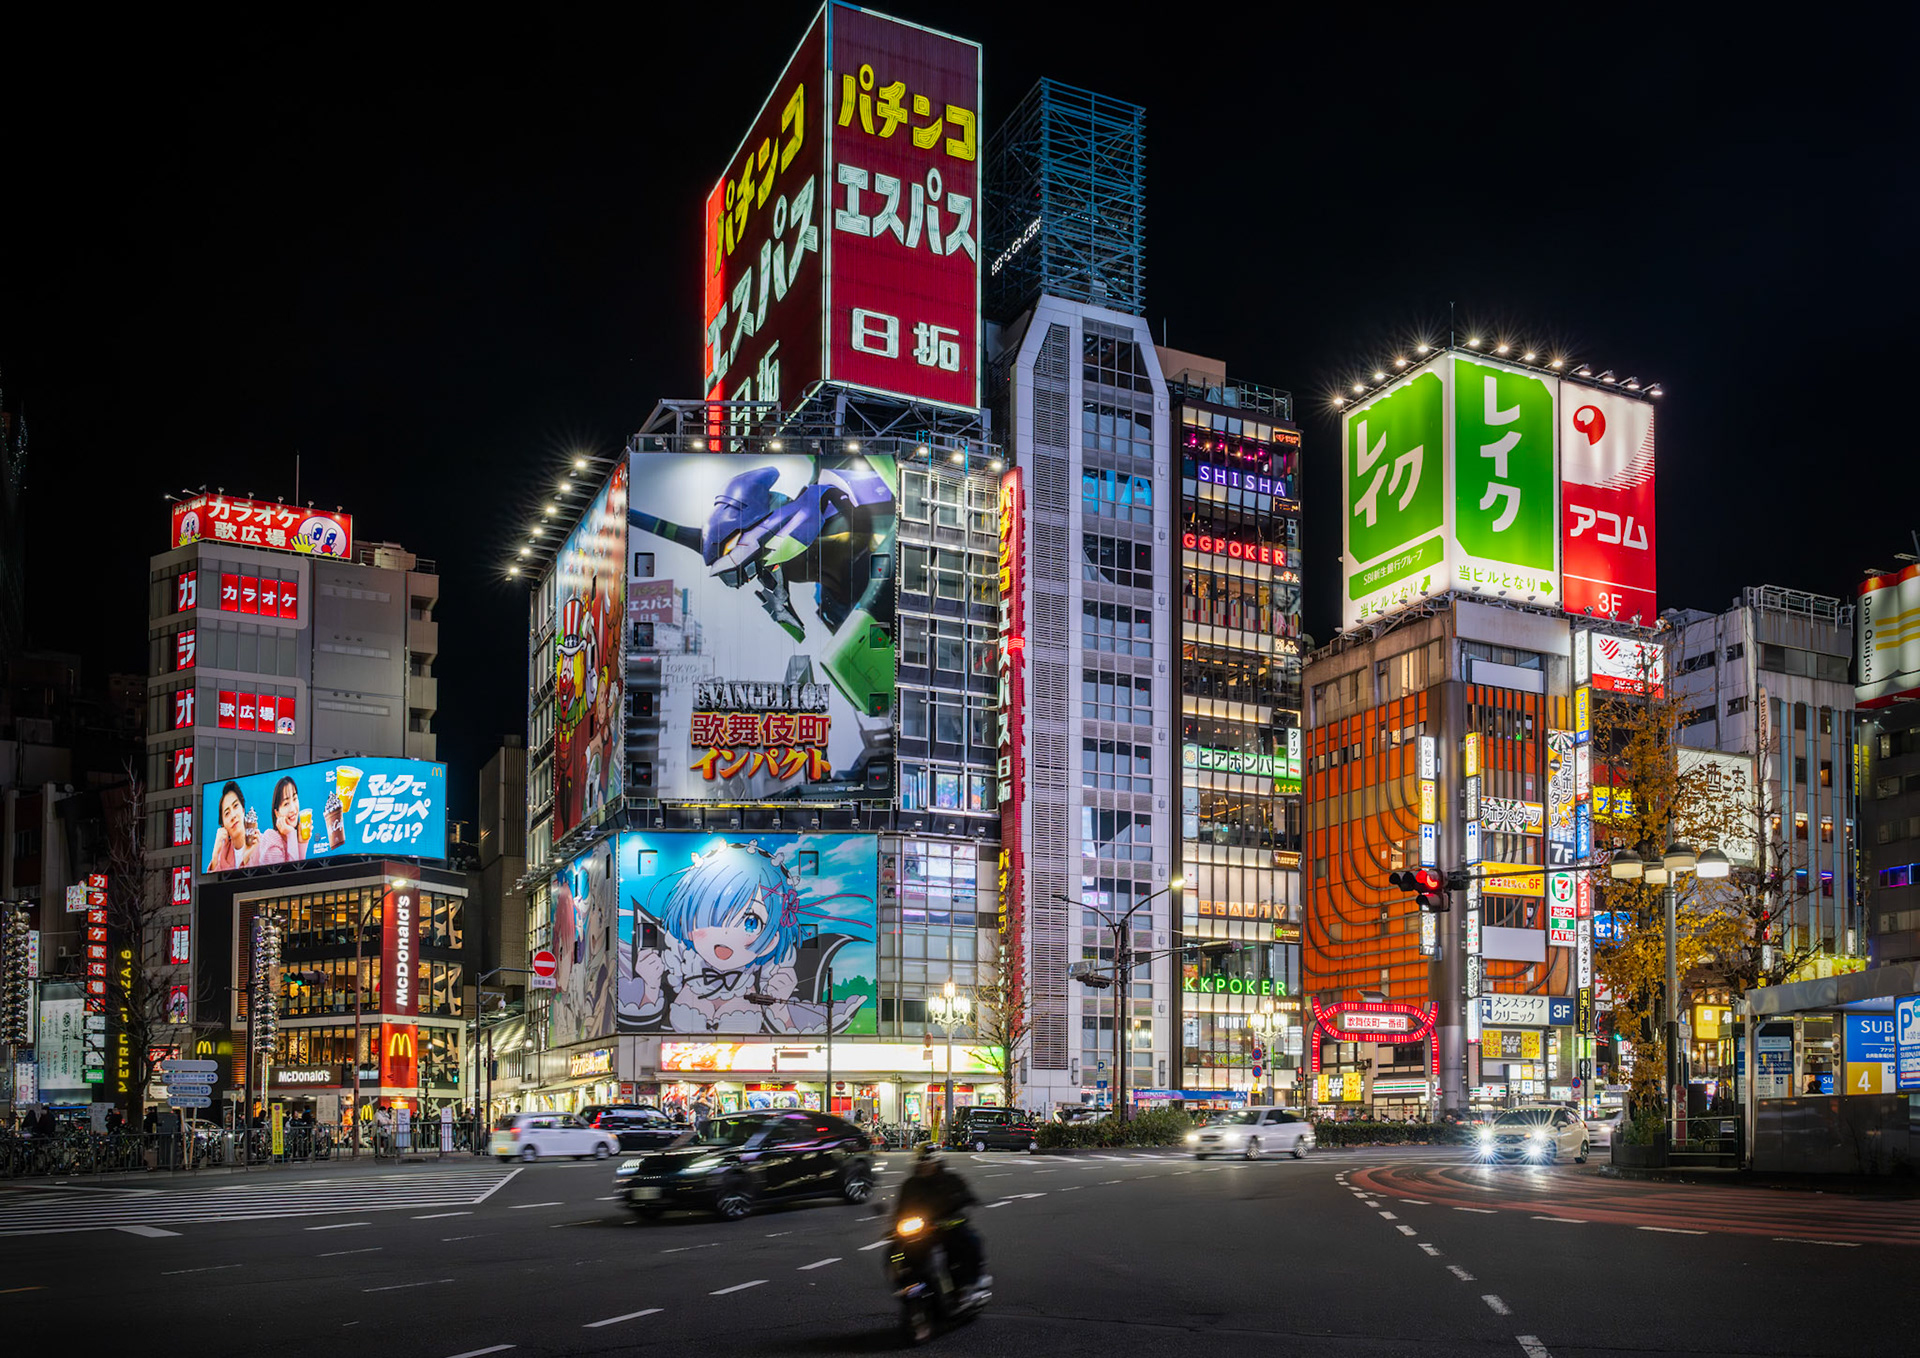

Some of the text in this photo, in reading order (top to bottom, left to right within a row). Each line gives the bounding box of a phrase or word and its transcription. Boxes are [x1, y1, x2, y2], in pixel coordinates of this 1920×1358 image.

[838, 64, 976, 161] パチンコ
[714, 83, 804, 277] パチンコ
[835, 162, 977, 262] エスパス
[705, 174, 819, 395] エスパス
[851, 307, 960, 372] 日拓
[1480, 374, 1522, 533] レイク
[1200, 465, 1286, 497] SHISHA
[1354, 418, 1424, 529] レイク
[208, 499, 300, 529] カラオケ
[1569, 503, 1649, 551] アコム
[214, 521, 287, 547] 歌広場
[998, 484, 1012, 593] パチンコ
[1183, 533, 1286, 567] GGPOKER
[1363, 548, 1424, 585] SBI新生銀行グループ
[1458, 564, 1536, 593] 当ビルとなり
[222, 585, 297, 608] カラオケ
[629, 595, 674, 612] エスパス
[1360, 581, 1418, 620] 当ビルとなり
[1597, 592, 1623, 613] 3F
[1863, 596, 1874, 683] Don Quijote
[998, 598, 1012, 749] エスパス
[694, 682, 830, 711] EVANGELION
[218, 701, 276, 722] 歌広場
[690, 712, 832, 747] 歌舞伎町
[690, 746, 832, 780] インパクト
[1424, 739, 1432, 776] 小松ビル
[368, 774, 427, 797] マックで
[355, 797, 432, 825] フラッペ
[1597, 796, 1635, 815] プロミ
[361, 823, 424, 844] しない?
[1551, 842, 1573, 864] 7F
[1528, 878, 1541, 890] 6F
[1579, 883, 1587, 907] アコム
[1199, 900, 1287, 920] BEAUTY
[1553, 907, 1573, 918] たばこ
[92, 874, 106, 993] カラオケ歌広場
[1552, 931, 1574, 941] ATM
[395, 893, 410, 1008] McDonald's
[1184, 977, 1287, 997] KKPOKER
[1494, 996, 1544, 1010] メンズライフ
[1494, 1010, 1535, 1022] クリニック
[1553, 1004, 1570, 1019] 3F
[1347, 1017, 1405, 1029] 歌舞伎町一番街
[1901, 1008, 1913, 1041] P
[278, 1069, 331, 1084] McDonald's
[1857, 1070, 1871, 1092] 4
